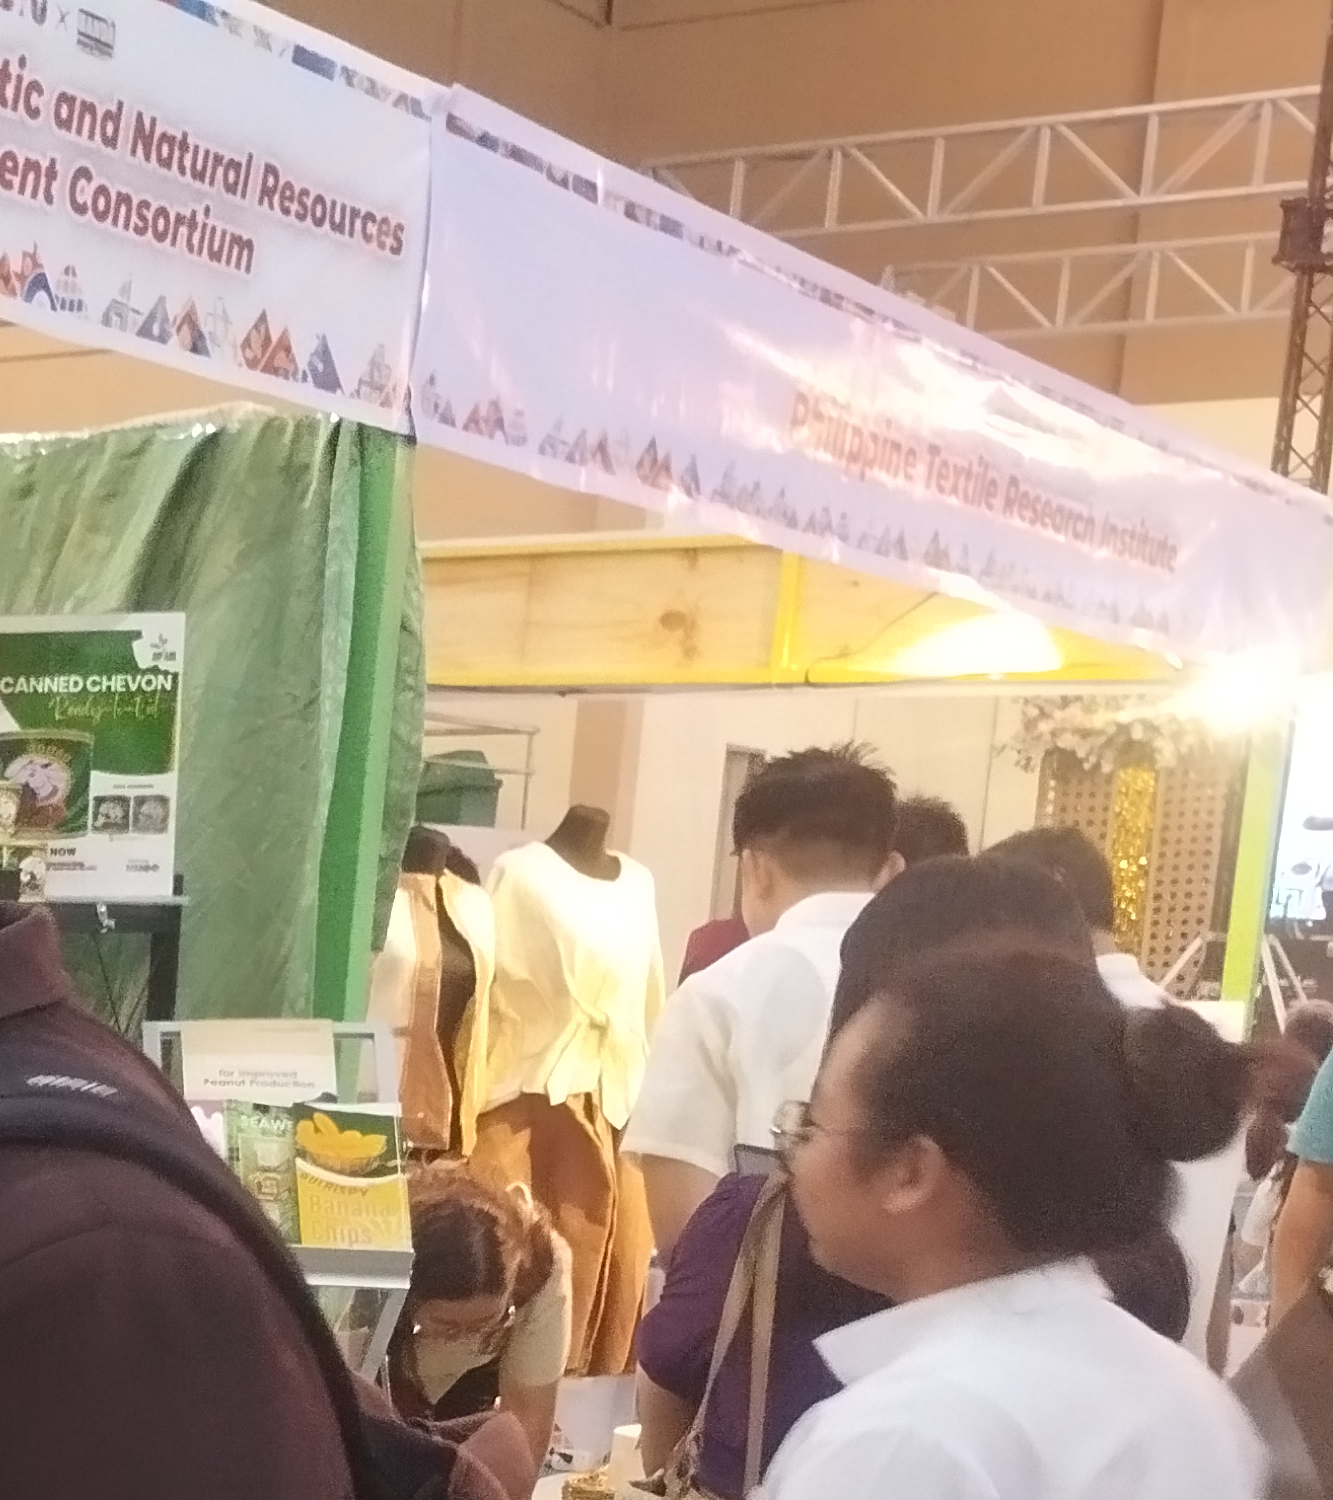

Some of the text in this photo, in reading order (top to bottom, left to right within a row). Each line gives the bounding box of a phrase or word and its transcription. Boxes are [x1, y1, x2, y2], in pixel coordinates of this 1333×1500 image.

[53, 90, 125, 152] and
[129, 108, 255, 200] Natural
[258, 160, 407, 257] Resources
[68, 165, 256, 275] Consortium
[925, 442, 1000, 513] Textile
[0, 674, 173, 695] CANNED CHEVON
